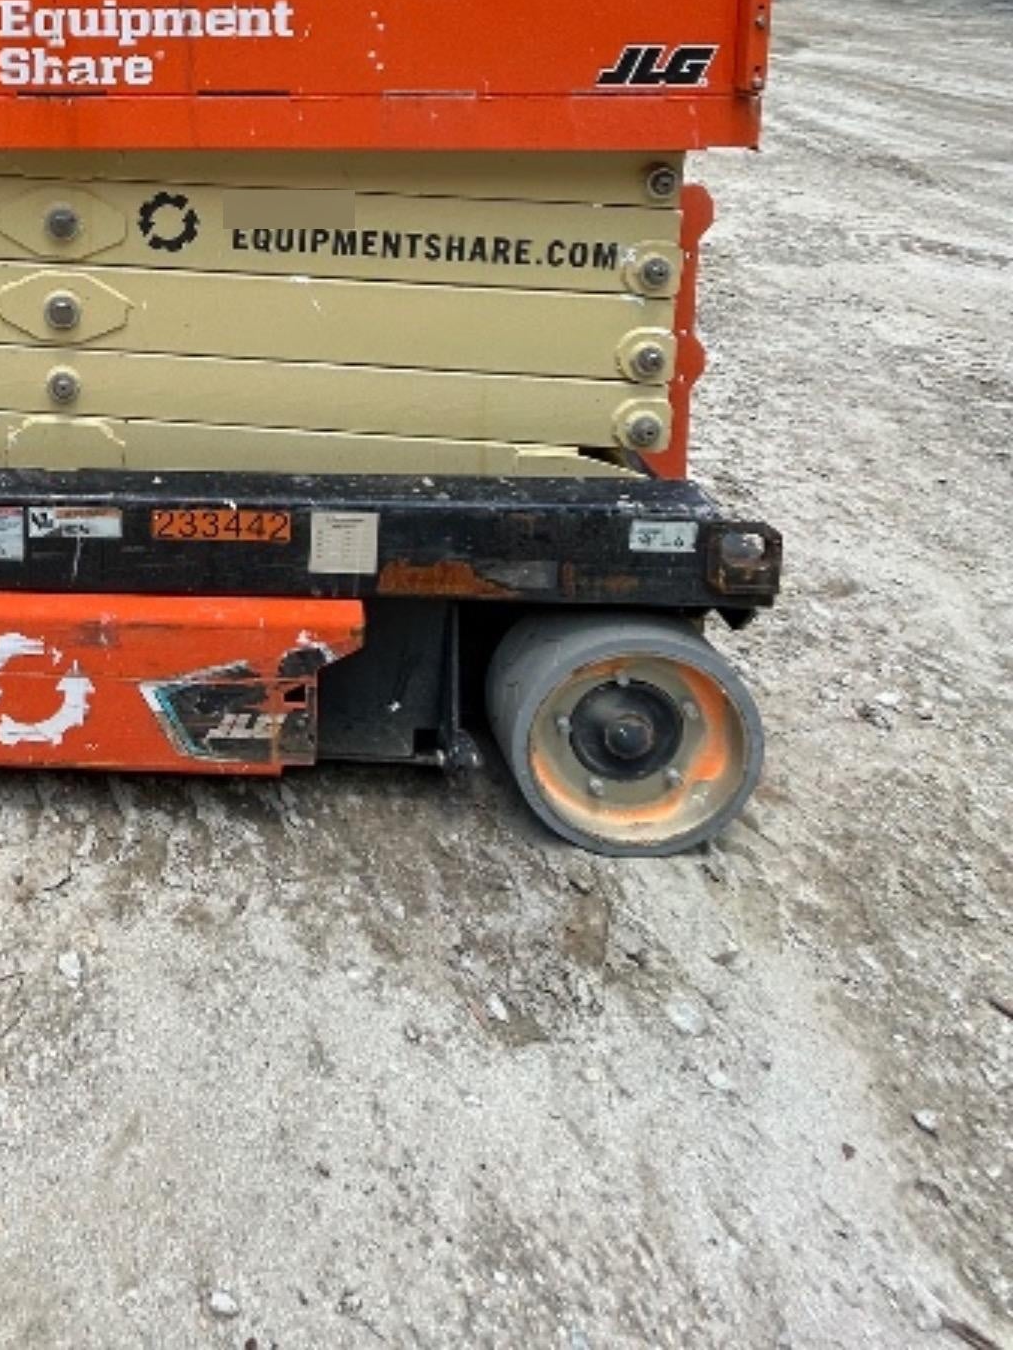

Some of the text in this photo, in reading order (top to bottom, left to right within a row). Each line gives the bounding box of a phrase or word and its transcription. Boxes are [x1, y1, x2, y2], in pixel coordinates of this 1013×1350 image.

[596, 44, 720, 87] JLG
[232, 228, 618, 270] EQUIPMENTSHARE.COM
[156, 512, 288, 540] 233442
